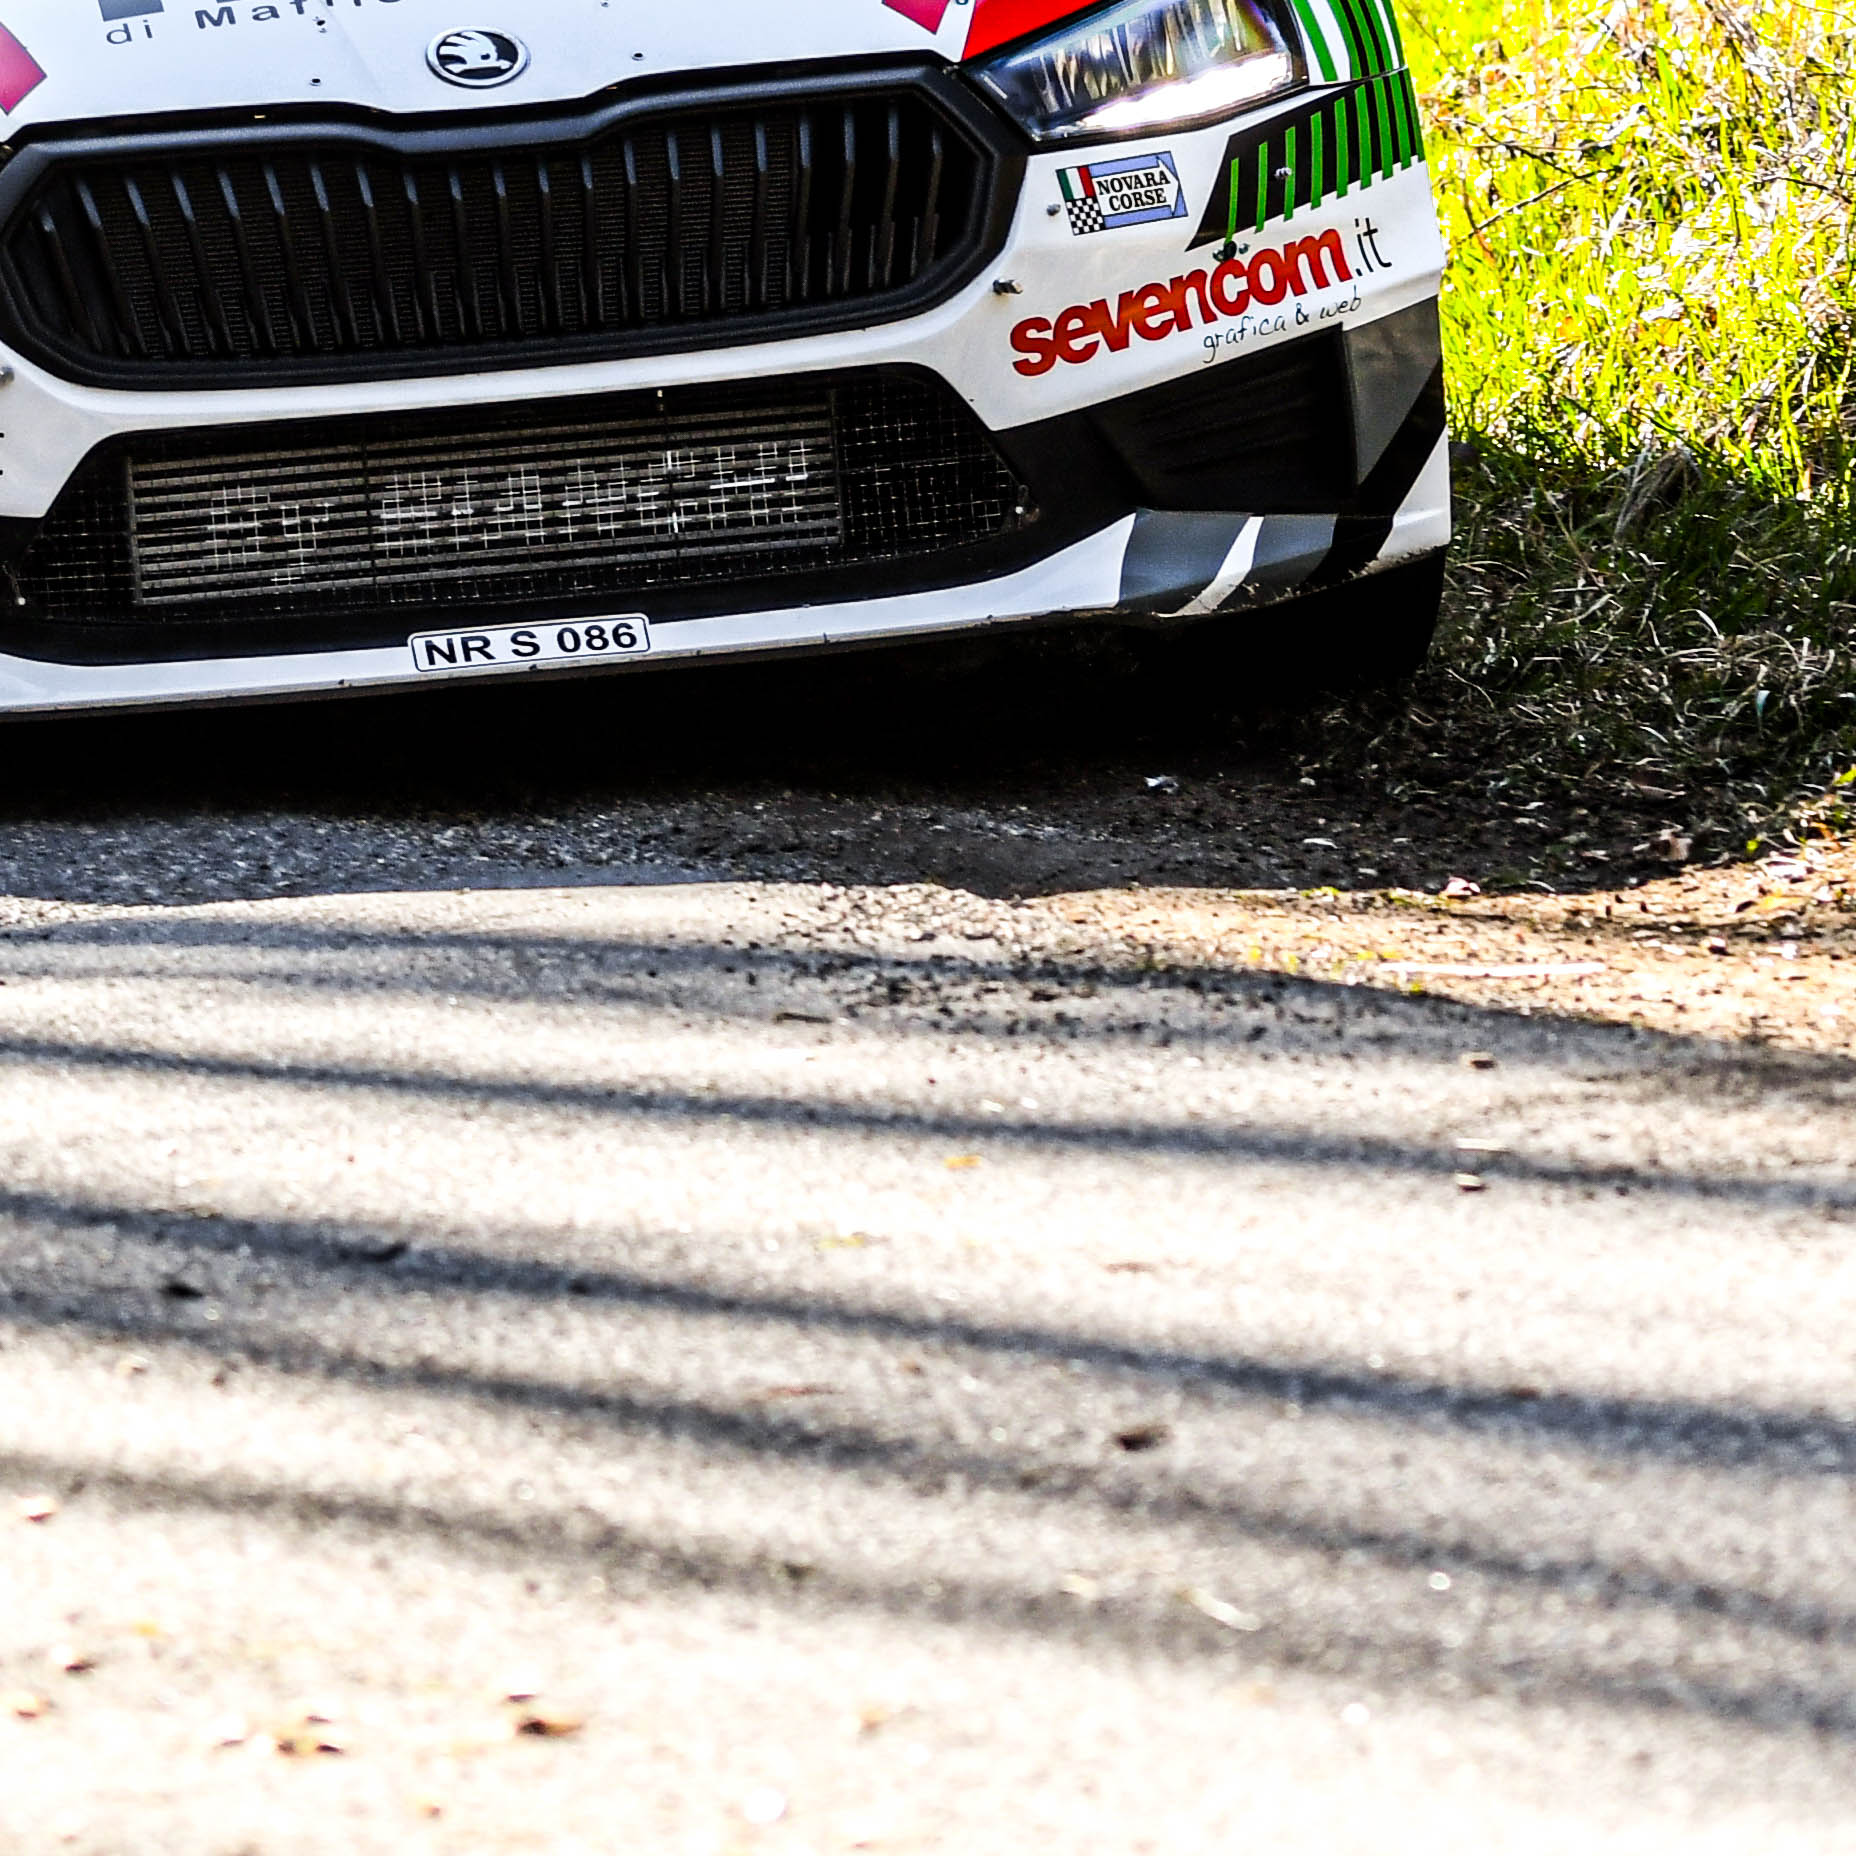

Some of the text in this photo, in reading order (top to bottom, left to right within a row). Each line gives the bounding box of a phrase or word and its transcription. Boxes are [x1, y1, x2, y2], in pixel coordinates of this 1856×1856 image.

[105, 19, 153, 46] di
[1096, 169, 1171, 196] NOVARA
[1108, 187, 1167, 212] CORSE
[1010, 217, 1393, 376] sevencom.it
[1202, 284, 1362, 364] grafica & web
[377, 440, 811, 560] BIANCHI
[424, 622, 638, 666] NR S 086
